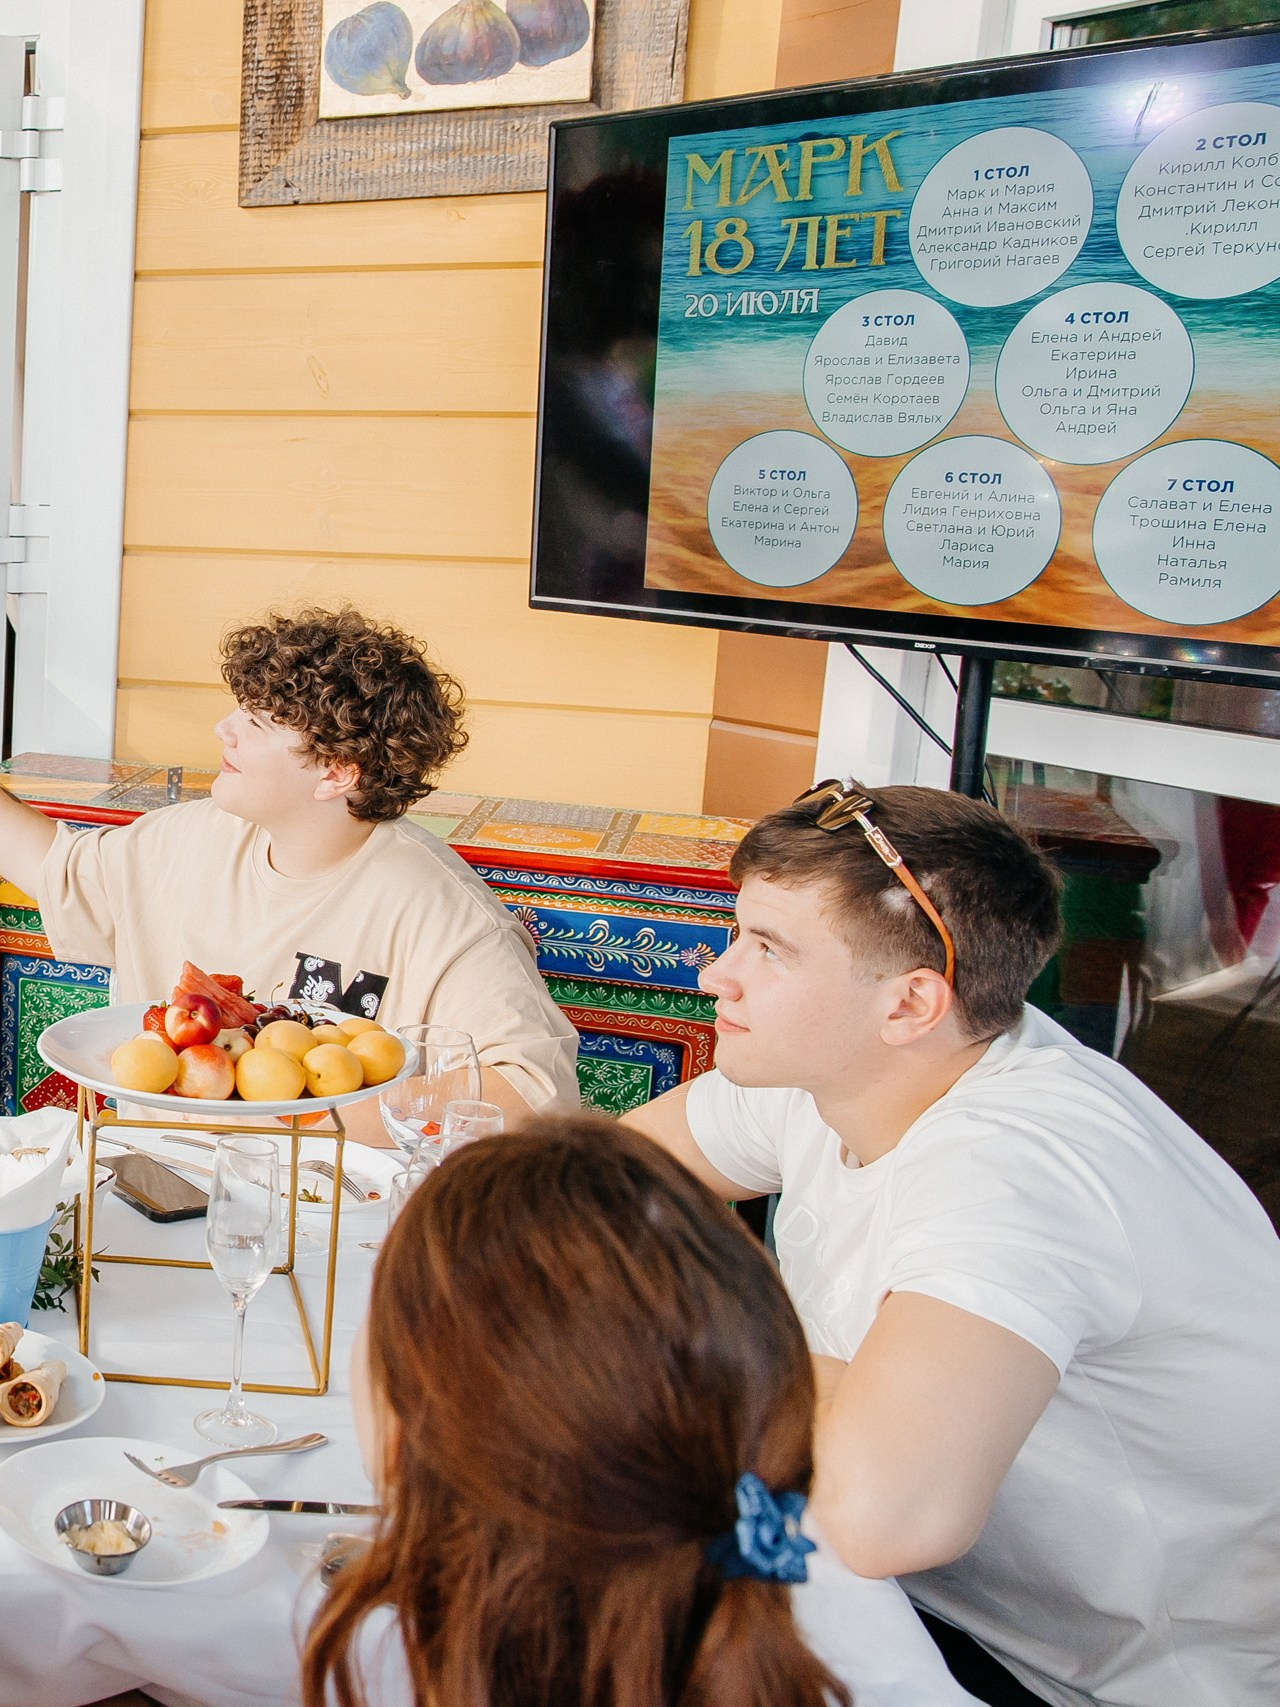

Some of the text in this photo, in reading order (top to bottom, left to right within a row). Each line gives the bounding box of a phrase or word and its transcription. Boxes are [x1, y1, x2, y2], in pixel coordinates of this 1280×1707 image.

[1196, 132, 1266, 151] 2 СТОЛ
[682, 130, 904, 211] МАРК
[974, 166, 1029, 181] 1 СТОЛ
[1159, 160, 1225, 175] Кирилл
[947, 183, 1054, 201] Марк и Мария
[1134, 180, 1237, 197] Константин
[1244, 179, 1254, 189] и
[942, 201, 1057, 218] Анна и Максим
[1138, 201, 1216, 220] Дмитрий
[917, 215, 1081, 239] Дмитрий Ивановский
[681, 210, 901, 276] 18 ЛЕТ
[917, 236, 1078, 254] Александр Кадников
[1143, 242, 1280, 259] Сергей Теркун
[930, 254, 1059, 272] Григорий Нагаев
[684, 289, 819, 317] 20 ИЮЛЯ
[862, 315, 914, 326] 3 СТОЛ
[1065, 311, 1129, 324] 4 СТОЛ
[865, 336, 908, 348] Давид
[1031, 328, 1161, 343] Елена и Андрей
[814, 355, 870, 367] Ярослав
[888, 354, 960, 365] Елизавета
[1051, 350, 1136, 362] Екатерина
[825, 374, 945, 386] Ярослав Гордеев
[1066, 367, 1117, 381] Ирина
[827, 393, 939, 405] Семён Коротаев
[1022, 385, 1161, 399] Ольга и Дмитрий
[1040, 403, 1137, 415] Ольга и Яна
[822, 412, 943, 423] Владислав Вялых
[1056, 421, 1116, 435] Андрей
[758, 470, 806, 481] 5 СТОЛ
[945, 472, 1002, 484] 6 СТОЛ
[734, 485, 777, 498] Виктор
[793, 488, 830, 499] Ольга
[1168, 479, 1234, 492] 7 СТОЛ
[912, 488, 969, 500] Евгений
[988, 491, 1035, 503] Алина
[733, 501, 768, 512] Елена
[784, 504, 829, 516] Сергей
[903, 504, 1041, 521] Лидия Генриховна
[1128, 496, 1272, 514] Салават и Елена
[722, 517, 784, 530] Екатерина
[800, 522, 839, 534] Антон
[906, 520, 1035, 539] Светлана и Юрий
[1130, 515, 1266, 533] Трошина Елена
[754, 535, 801, 548] Марина
[940, 539, 994, 553] Лариса
[1172, 536, 1216, 550] Инна
[942, 556, 989, 570] Мария
[1158, 554, 1227, 570] Наталья
[1159, 573, 1222, 589] Рамиля
